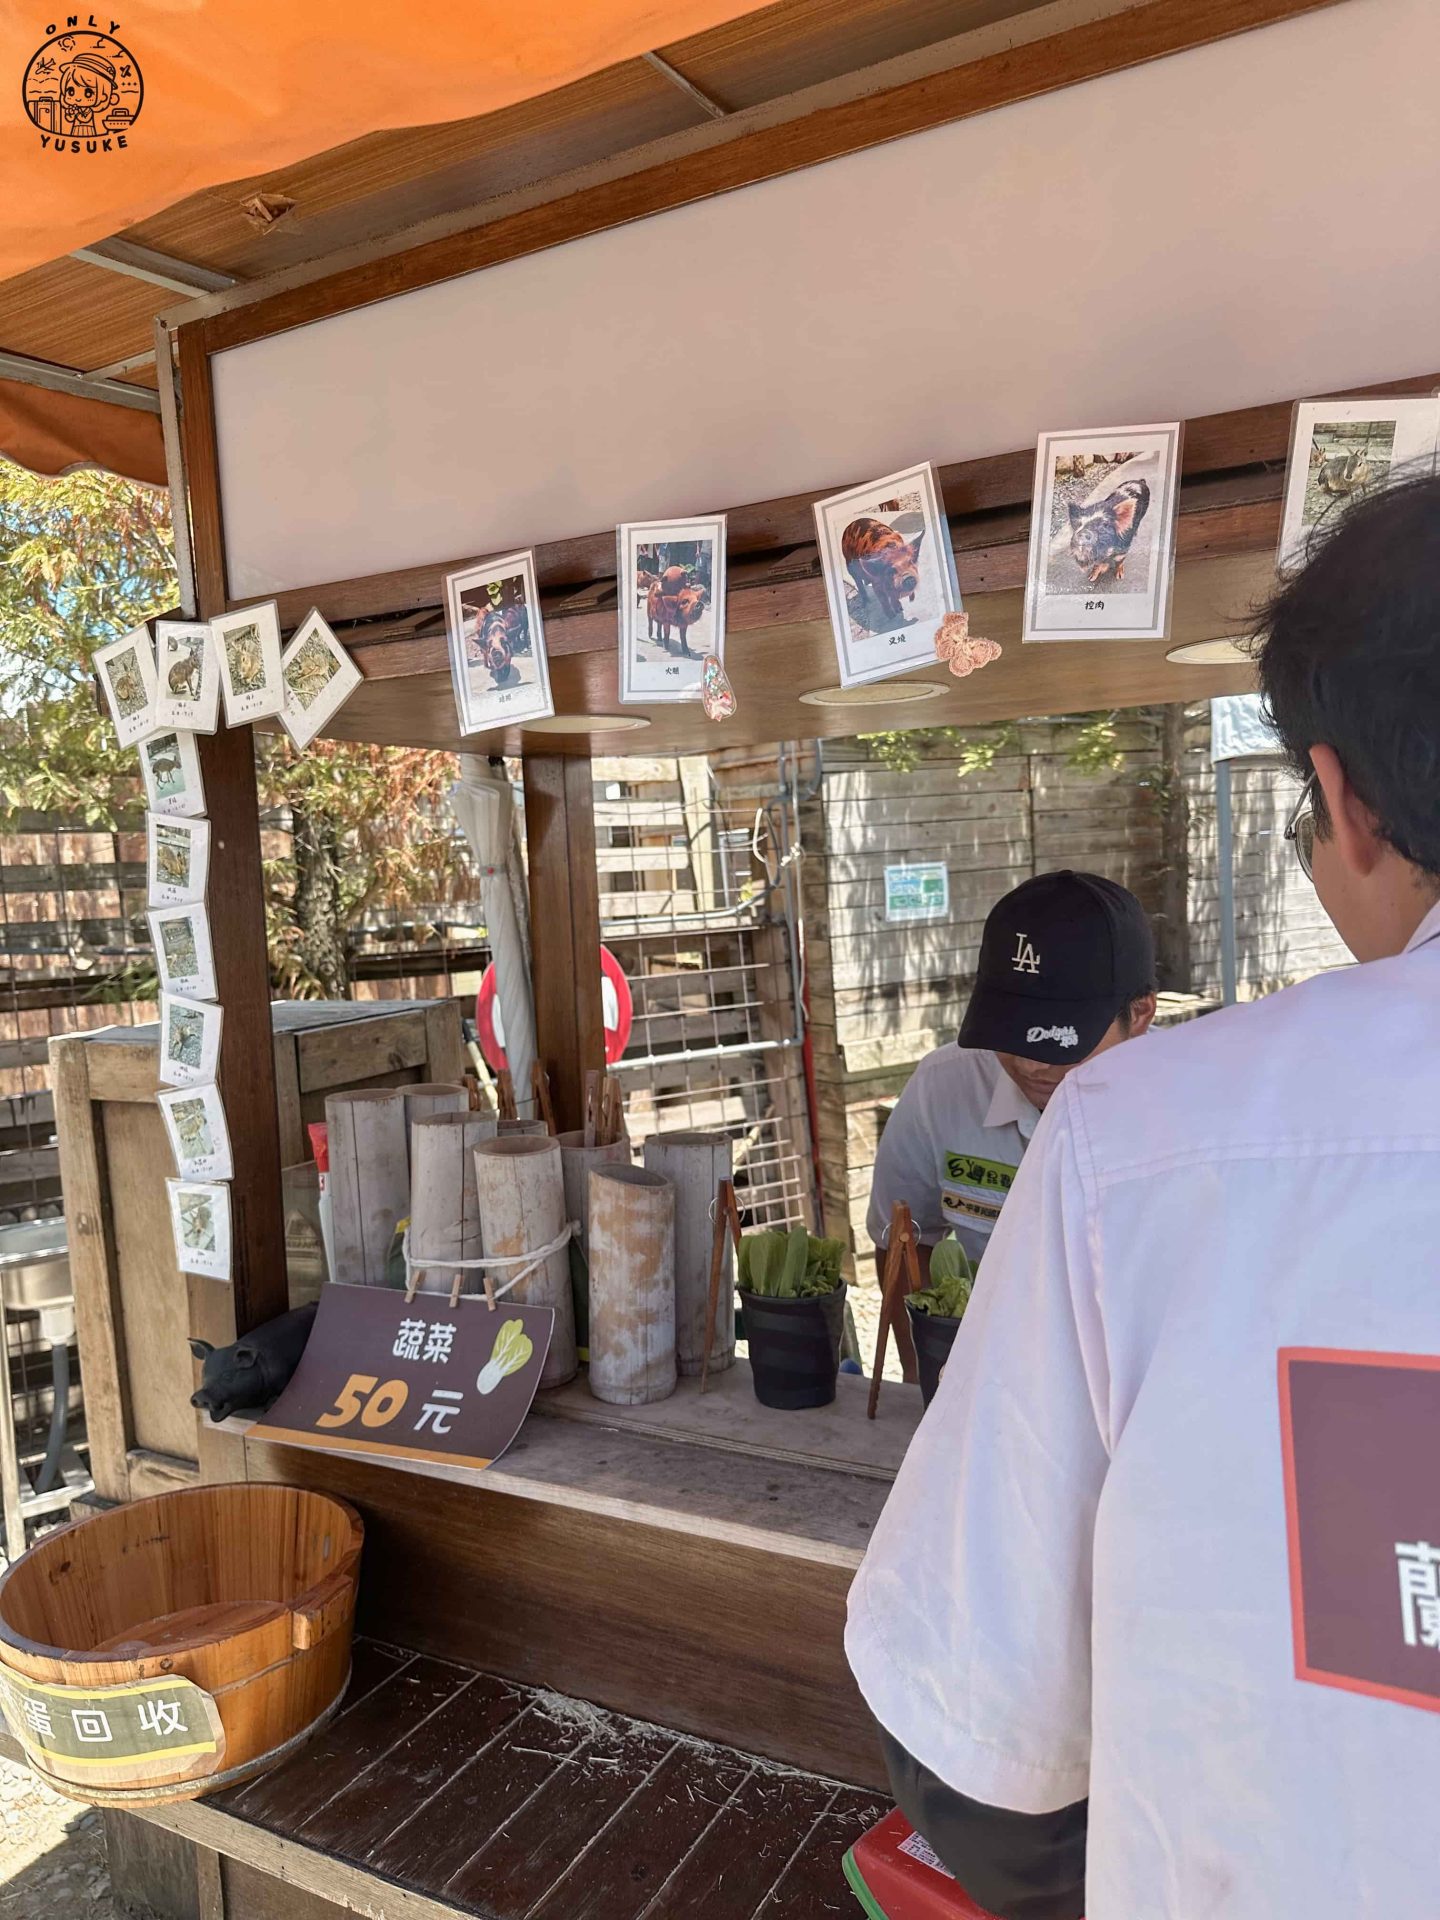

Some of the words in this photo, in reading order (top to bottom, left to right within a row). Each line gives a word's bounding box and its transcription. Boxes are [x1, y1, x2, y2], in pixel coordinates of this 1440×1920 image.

[1012, 932, 1041, 974] LA
[392, 1317, 457, 1364] 蔬菜
[315, 1374, 409, 1428] 50
[413, 1389, 464, 1434] 元
